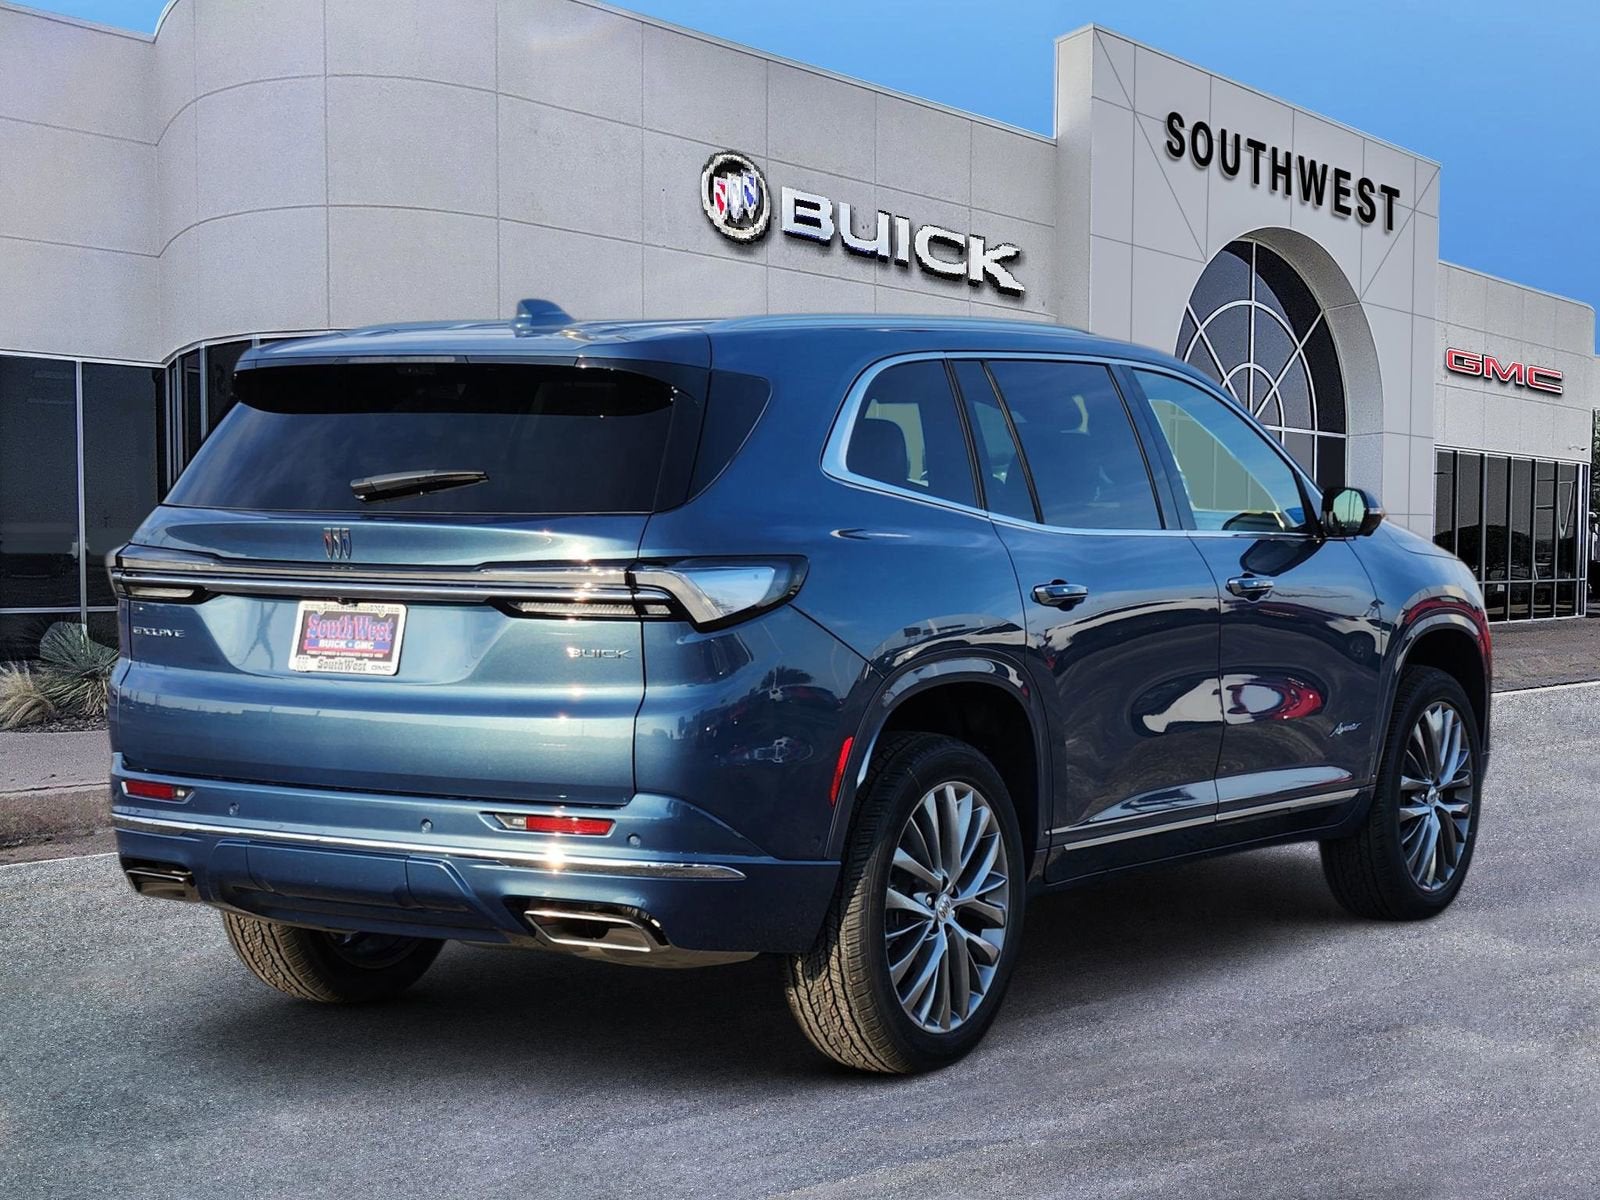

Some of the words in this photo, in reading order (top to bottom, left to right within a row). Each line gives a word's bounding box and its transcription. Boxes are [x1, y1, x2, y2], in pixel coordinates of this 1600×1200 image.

[1165, 111, 1401, 232] SOUTHWEST
[781, 186, 1025, 297] BUICK
[1446, 347, 1563, 396] GMC
[319, 640, 346, 649] BUICK
[566, 647, 633, 659] BUICK
